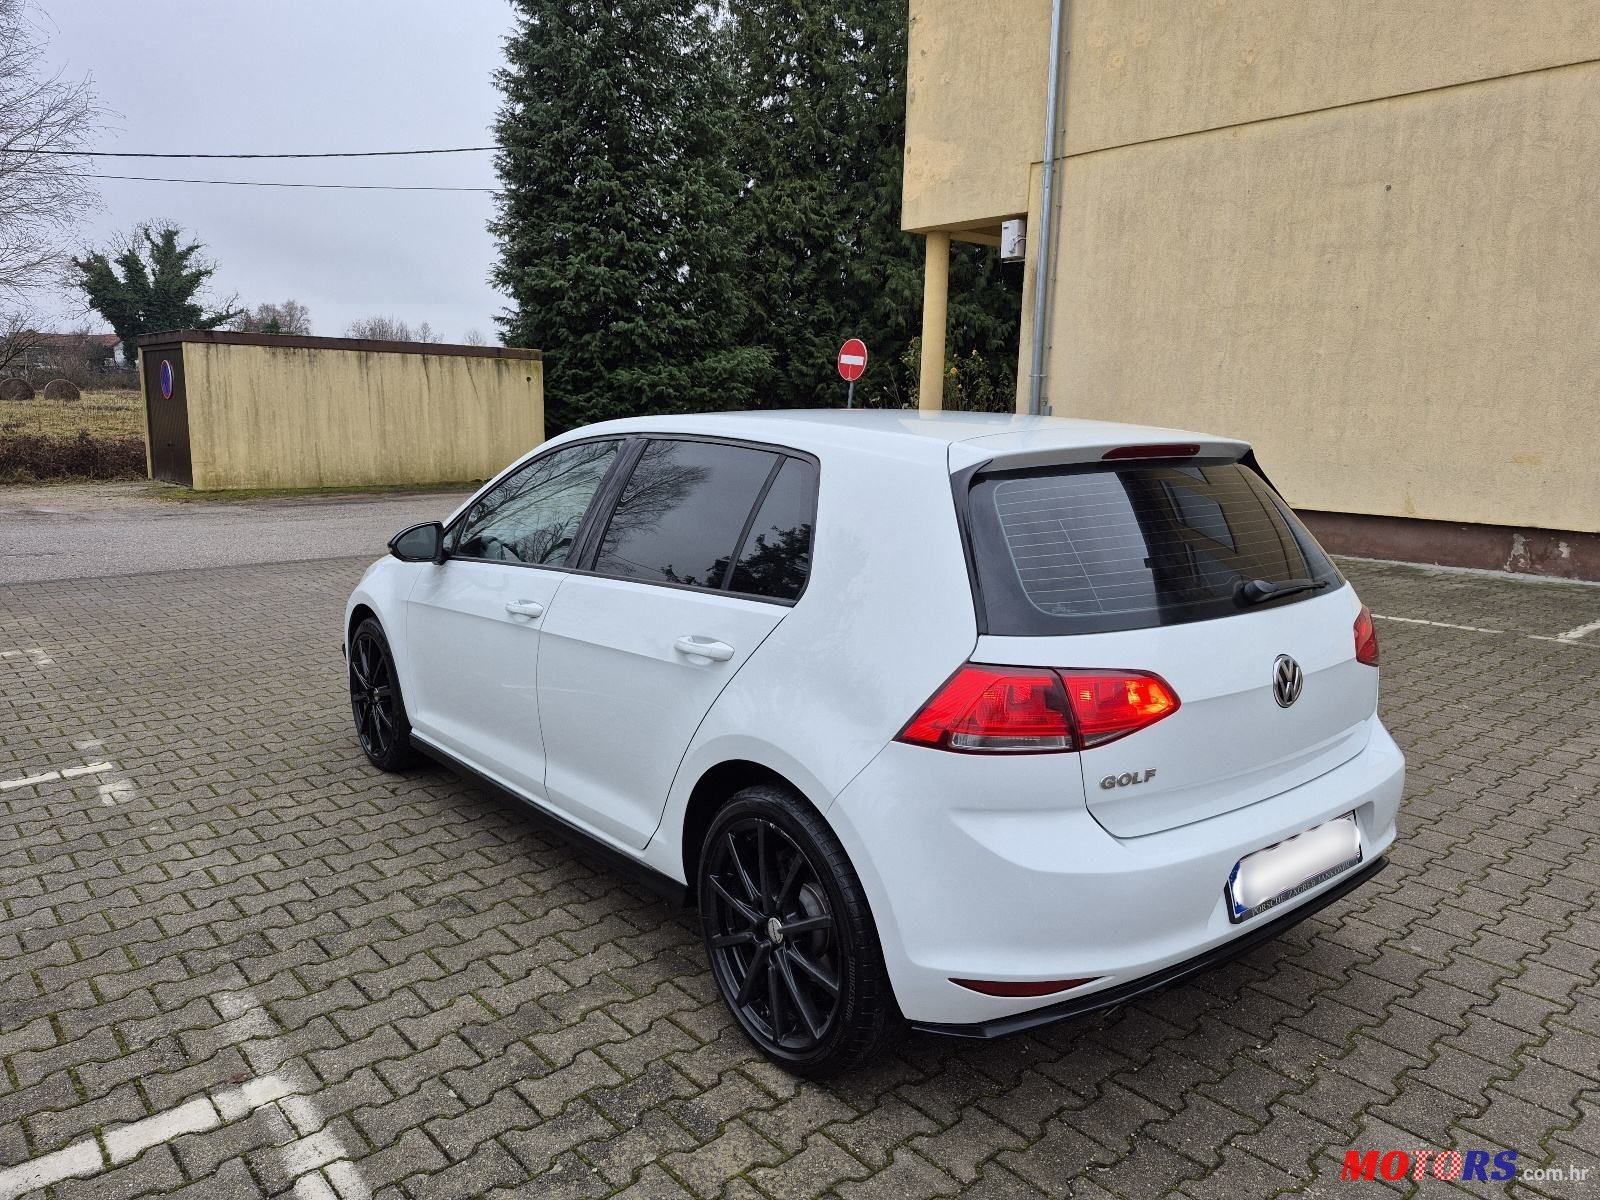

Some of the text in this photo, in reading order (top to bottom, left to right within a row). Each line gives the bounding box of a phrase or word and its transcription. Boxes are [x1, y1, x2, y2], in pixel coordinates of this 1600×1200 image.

[1273, 653, 1303, 708] VW
[1100, 767, 1156, 789] GOLF
[1251, 894, 1286, 917] PORSCHE
[1288, 880, 1317, 900] ZAGREB
